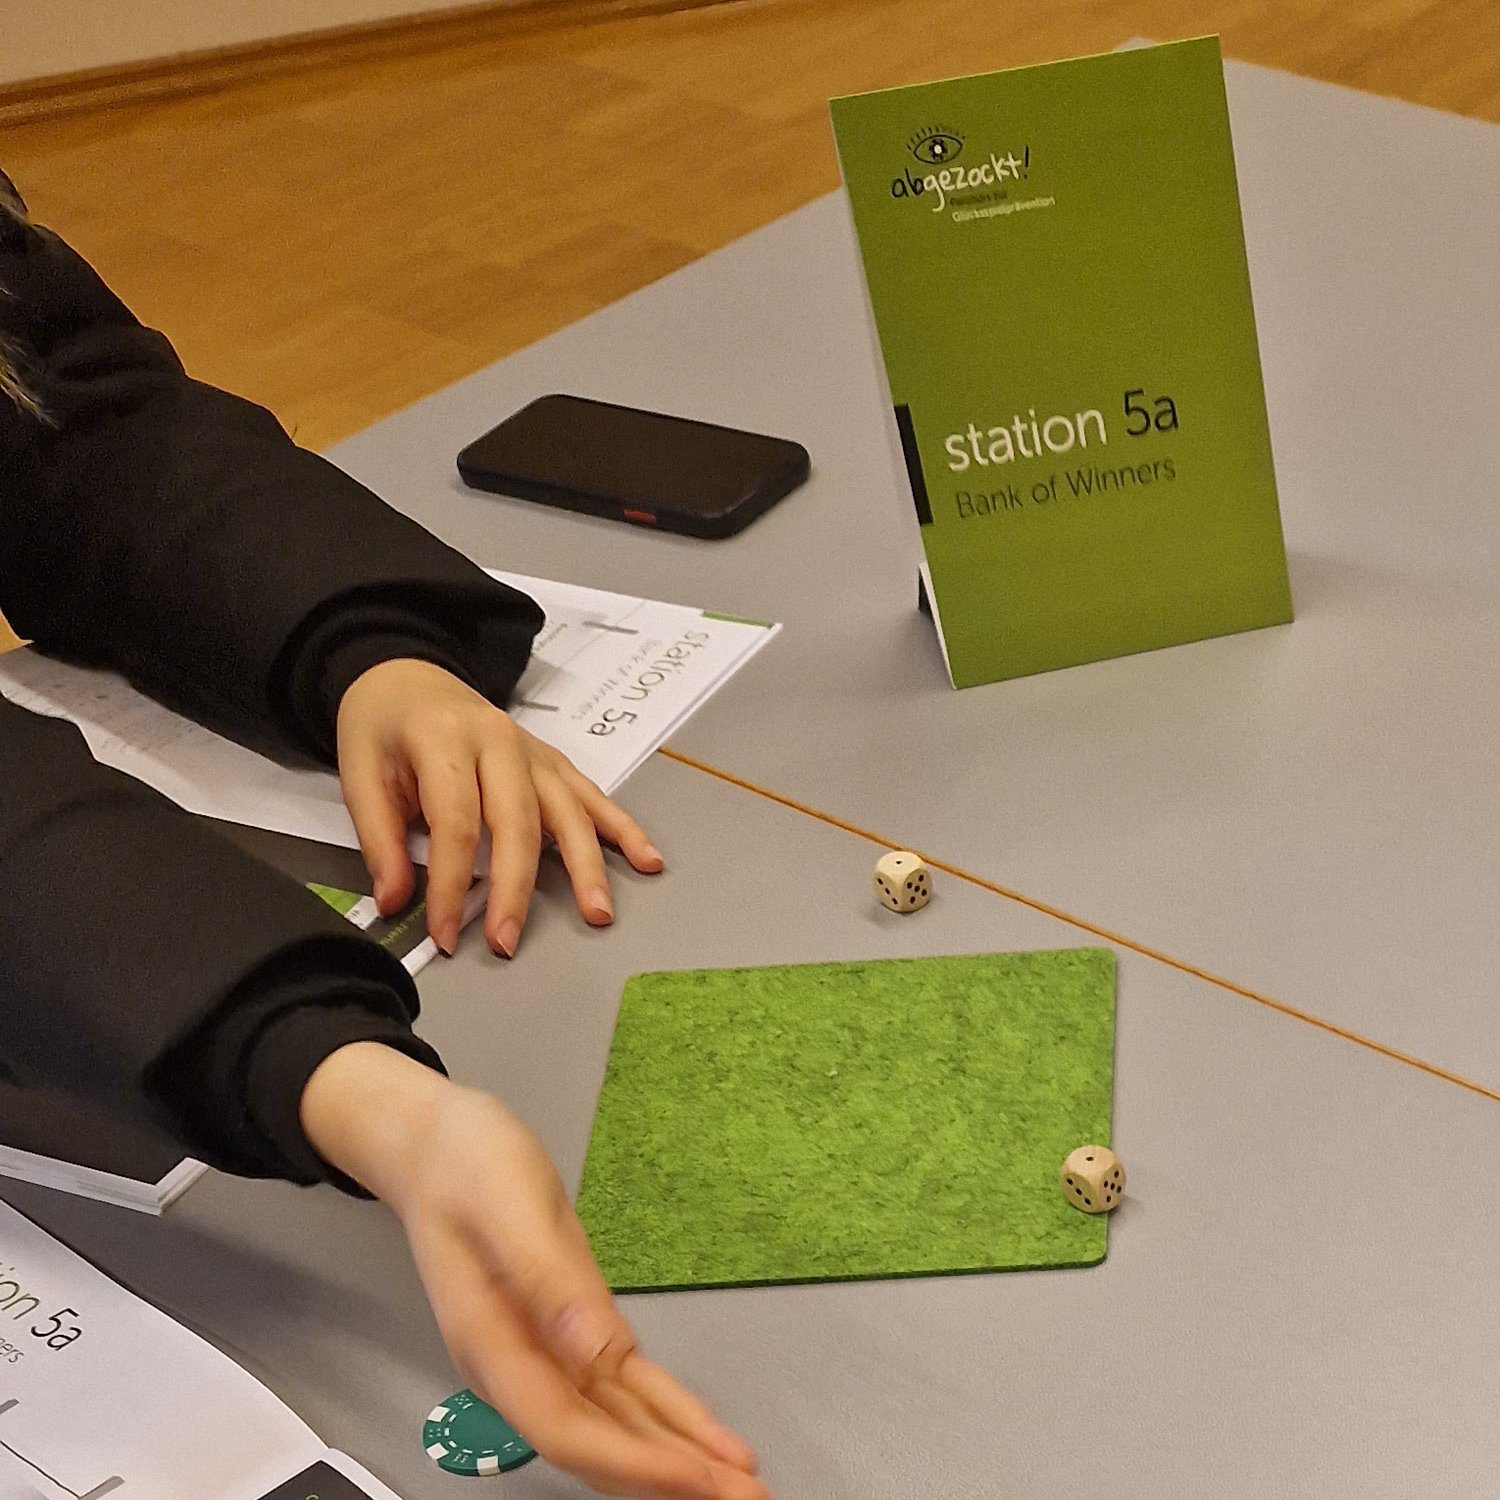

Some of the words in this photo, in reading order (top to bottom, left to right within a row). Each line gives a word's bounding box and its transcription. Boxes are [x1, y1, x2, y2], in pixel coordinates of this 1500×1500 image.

[891, 144, 1029, 213] abgezockt!
[944, 404, 1107, 472] station
[1123, 388, 1179, 438] 5a
[956, 486, 1022, 520] Bank
[1031, 473, 1060, 506] of
[1065, 456, 1177, 500] Winners
[621, 631, 709, 702] station
[586, 706, 638, 737] 5a
[30, 1307, 83, 1352] 5a
